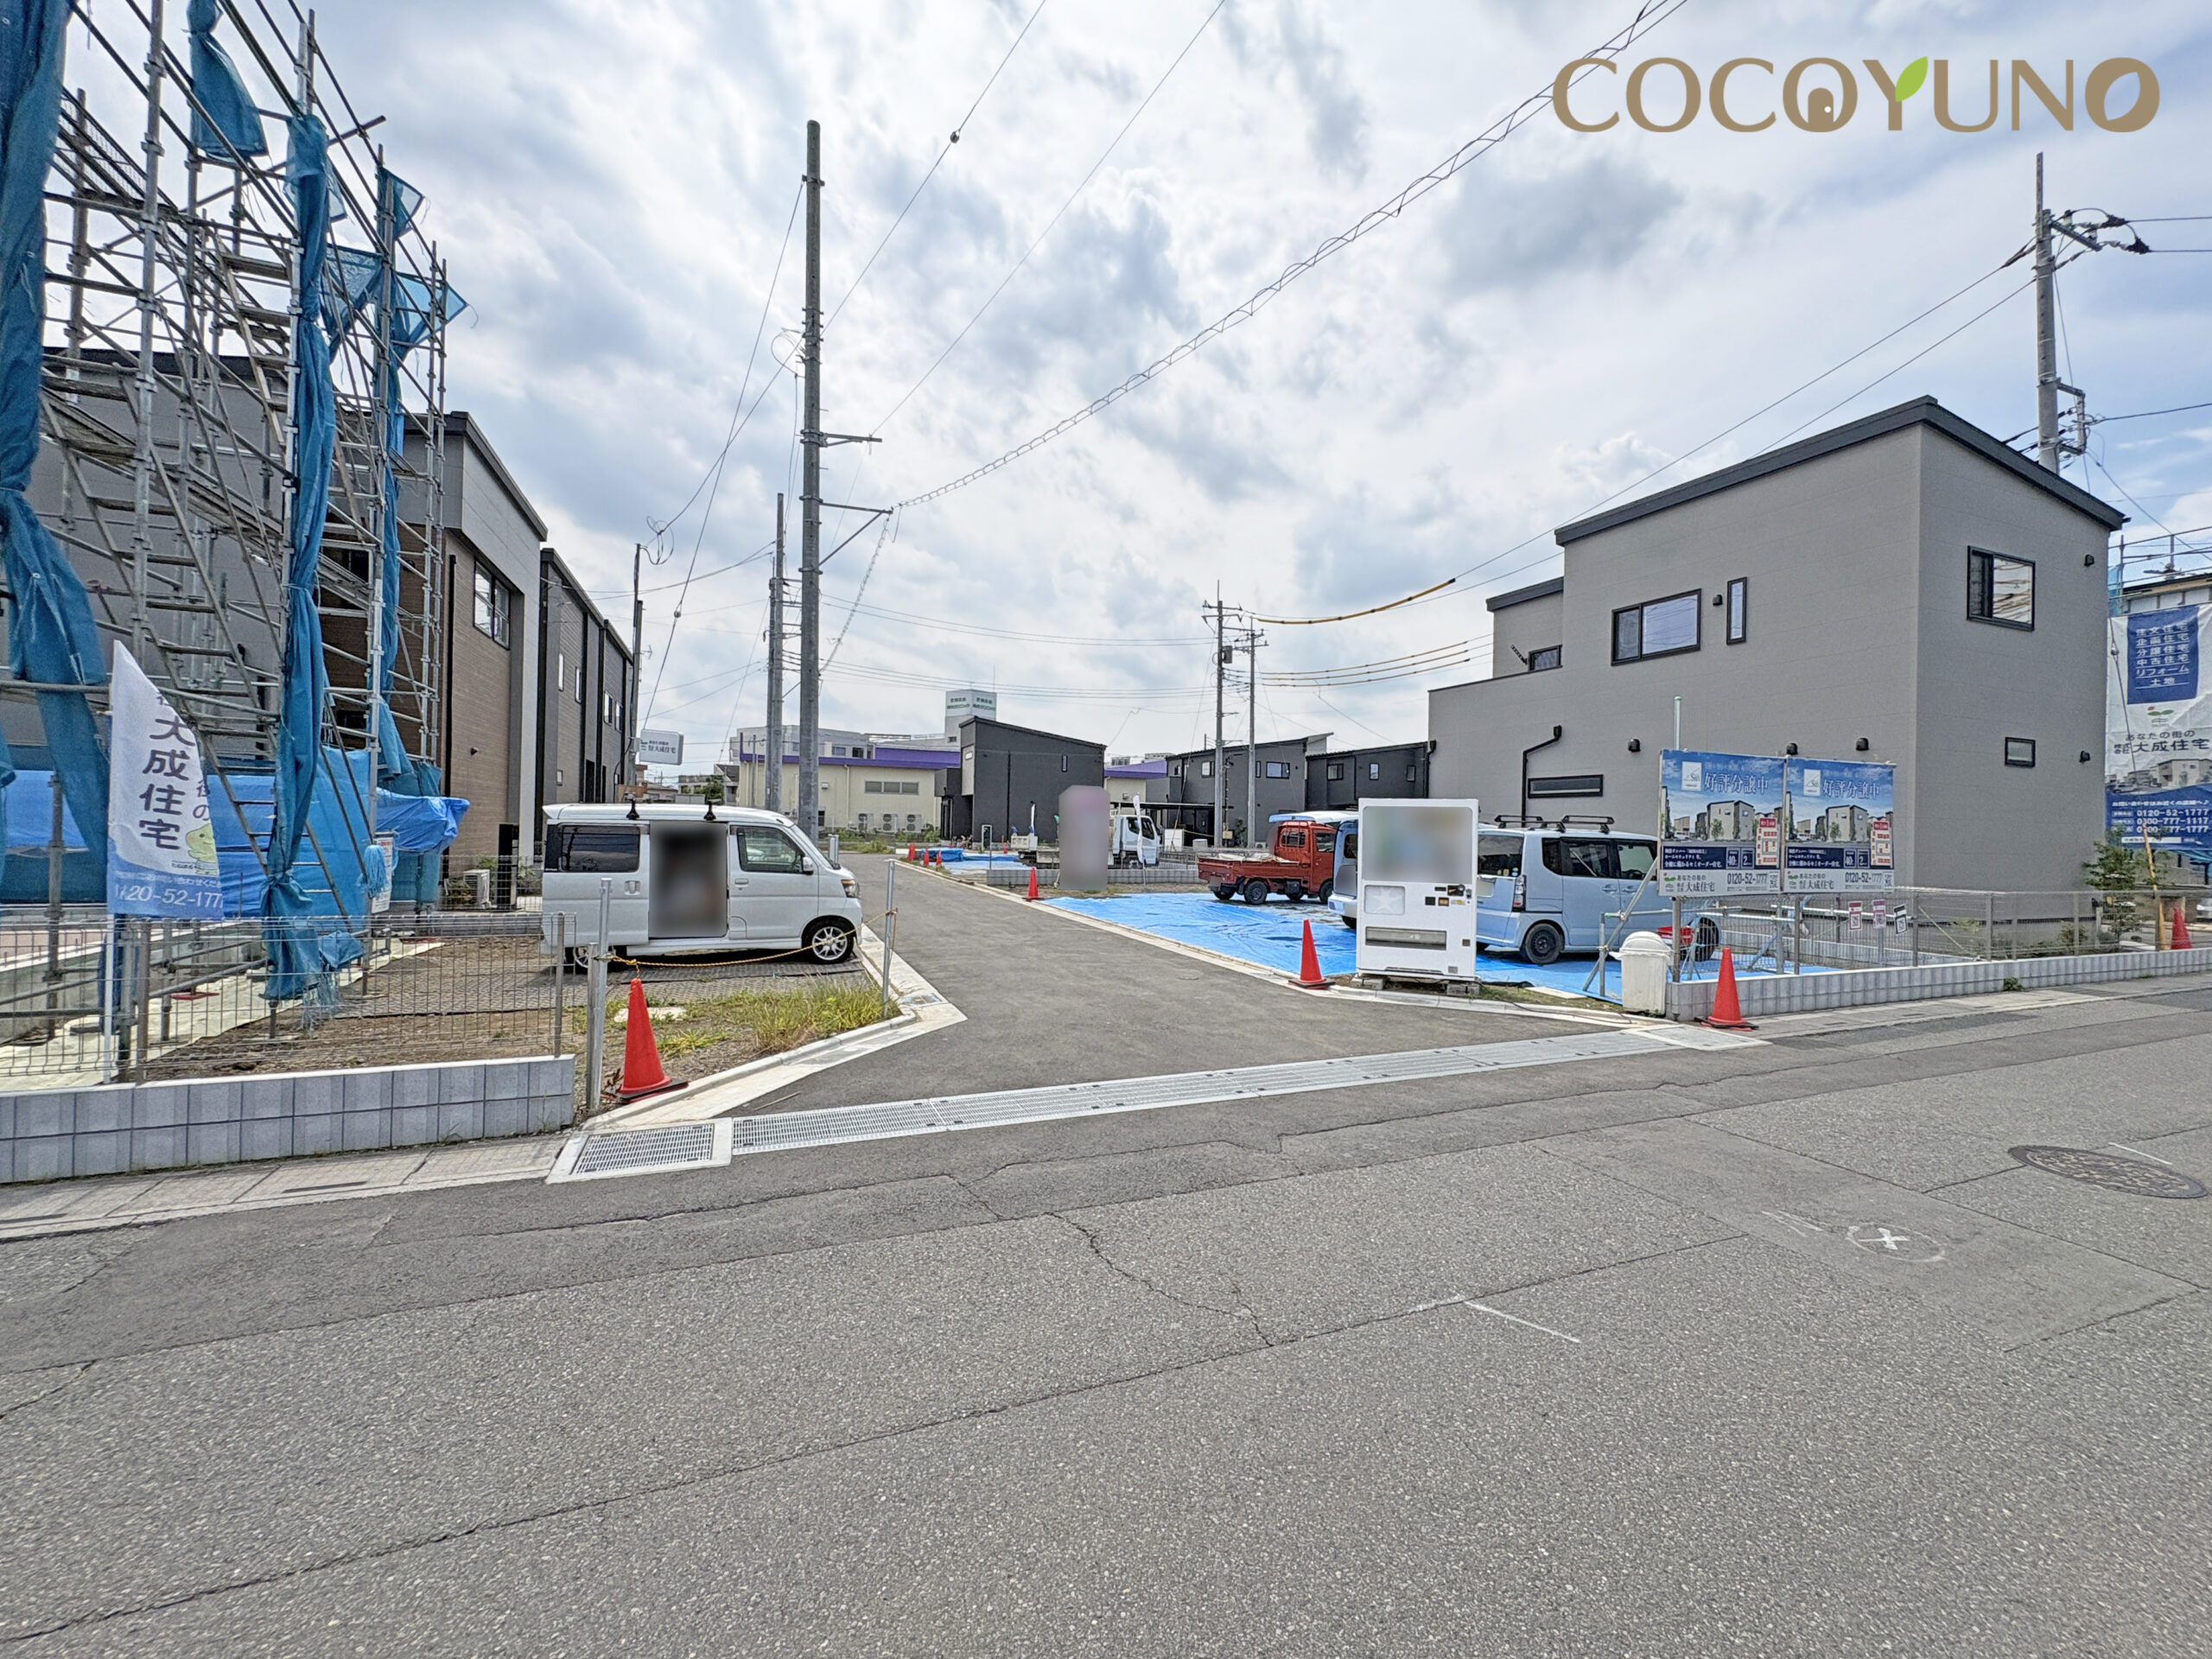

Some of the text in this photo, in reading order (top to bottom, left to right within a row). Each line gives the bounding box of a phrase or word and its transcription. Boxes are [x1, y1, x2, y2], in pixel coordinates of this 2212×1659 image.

[2136, 633, 2190, 646] 企画住宅
[2136, 644, 2190, 657] 分譲住宅
[2137, 654, 2189, 666] 中古住宅
[2137, 664, 2189, 677] リフォーム
[2151, 677, 2175, 686] 土地
[2126, 730, 2196, 741] あなたの街の
[2132, 739, 2209, 753] 大成住宅
[139, 715, 196, 850] 大成住宅
[1704, 772, 1769, 795] 好評分譲中
[1822, 779, 1880, 799] 好評分譲中
[1685, 881, 1715, 892] 大成住宅
[1808, 880, 1834, 890] 大成住宅
